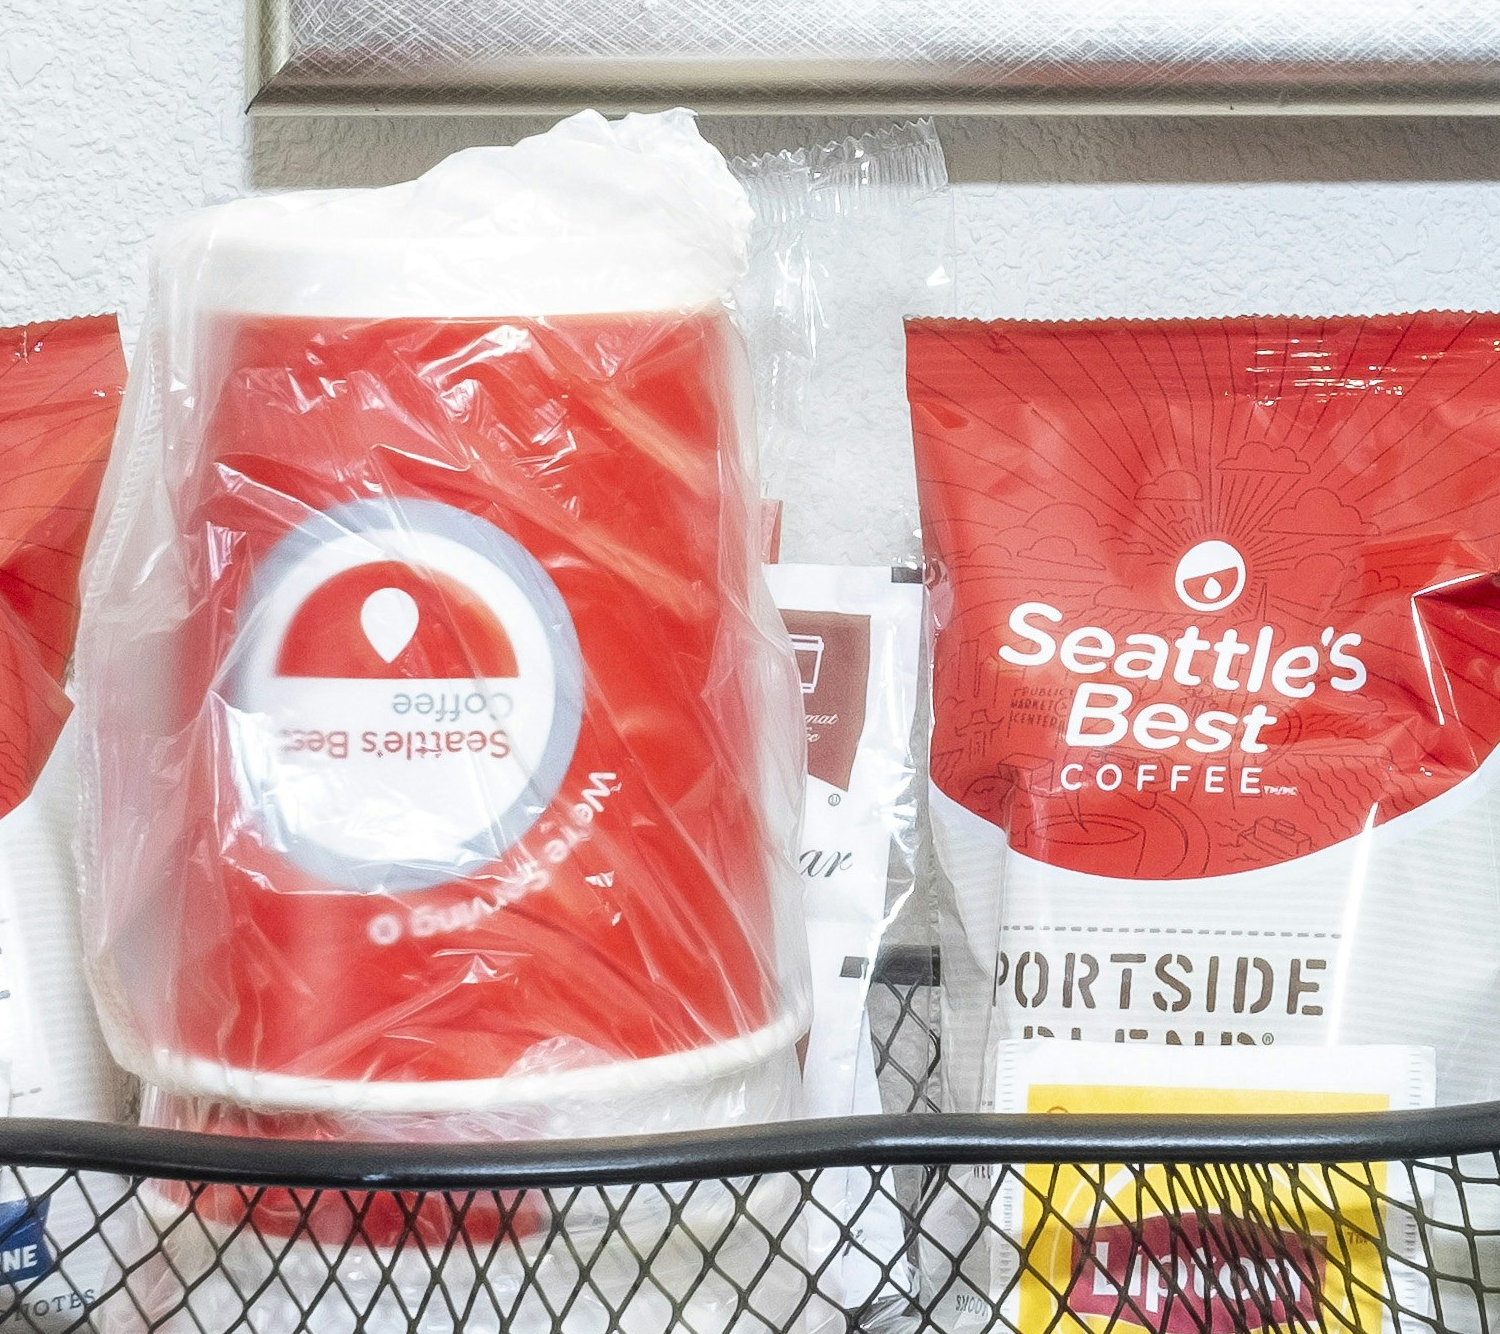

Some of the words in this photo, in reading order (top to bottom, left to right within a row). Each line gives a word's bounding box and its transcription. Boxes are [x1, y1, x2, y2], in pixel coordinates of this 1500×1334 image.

[998, 601, 1367, 698] Seattle's
[392, 692, 514, 722] Coffee
[1065, 682, 1278, 753] Best
[361, 730, 511, 761] Seattle's
[1060, 763, 1263, 795] COFFEE
[991, 951, 1327, 1016] PORTSIDE
[1092, 1241, 1301, 1313] Lipton
